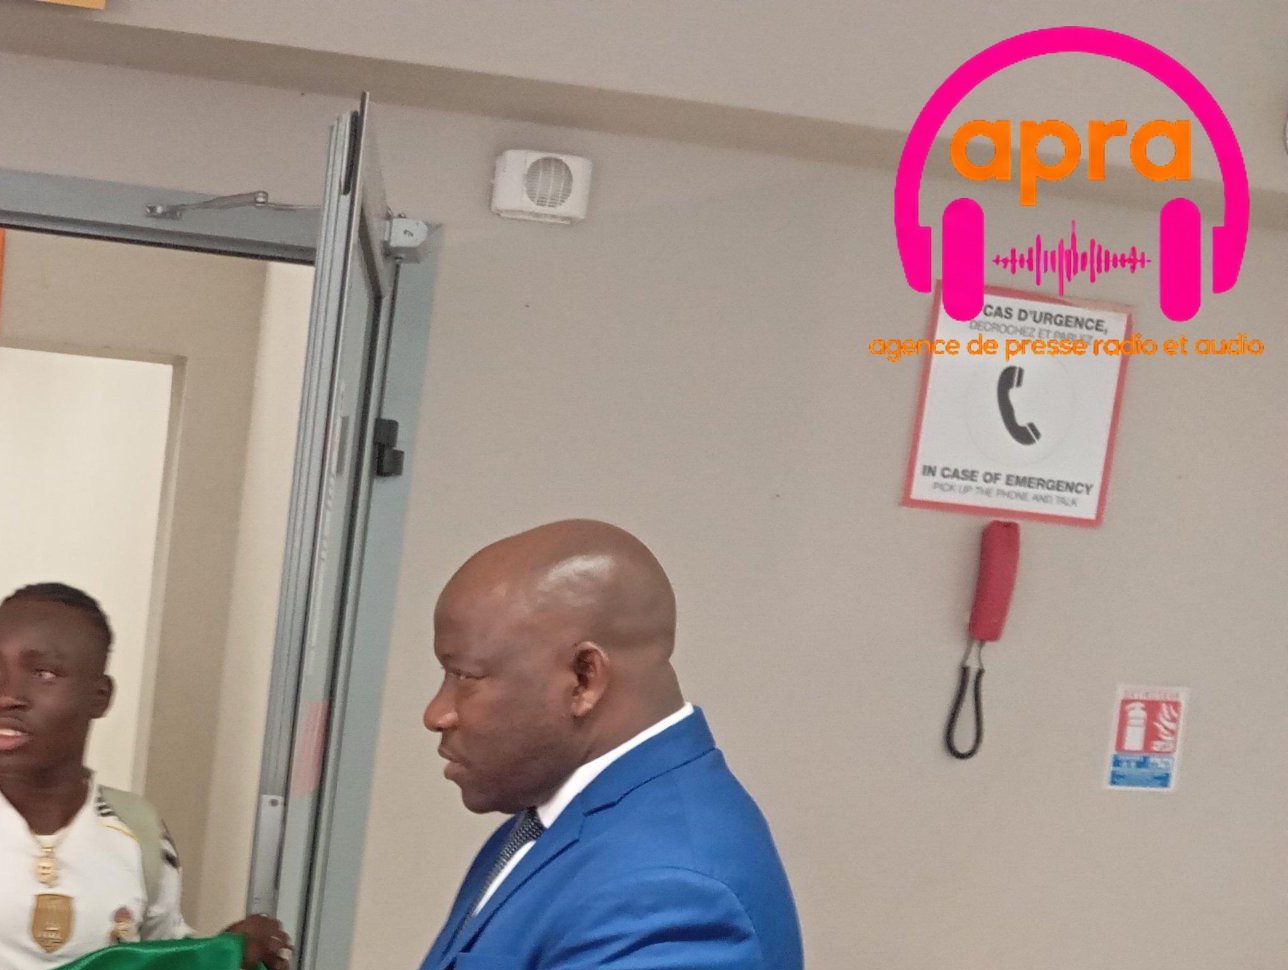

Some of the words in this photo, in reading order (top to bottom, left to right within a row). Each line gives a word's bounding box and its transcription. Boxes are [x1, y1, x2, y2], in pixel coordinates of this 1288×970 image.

[982, 304, 1013, 320] CAS
[1017, 308, 1108, 335] D'URGENCE,
[922, 464, 938, 477] IN
[941, 466, 979, 482] CASE
[982, 471, 1002, 485] OF
[1005, 474, 1094, 496] EMERGENCY
[932, 481, 955, 494] PICK
[958, 484, 973, 495] UP
[975, 486, 993, 497] THE
[996, 488, 1029, 502] PHONE
[1031, 493, 1054, 505] AND
